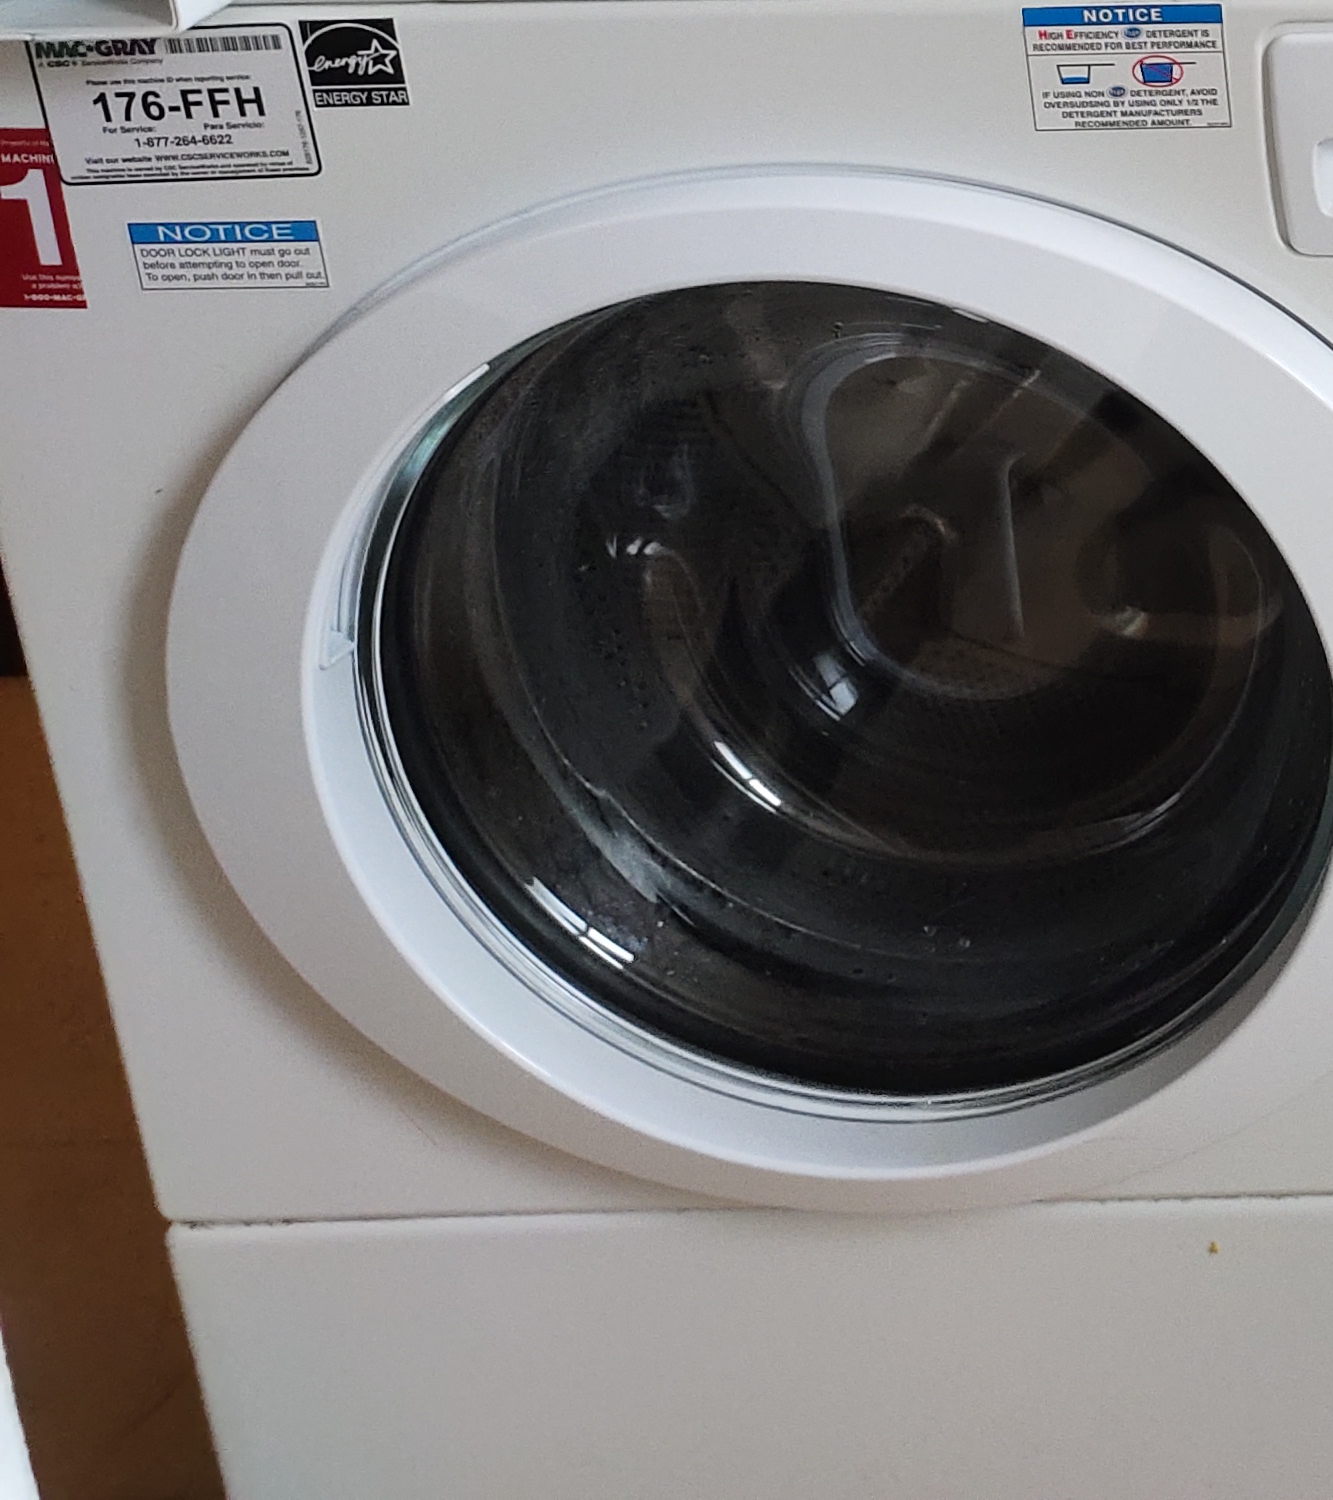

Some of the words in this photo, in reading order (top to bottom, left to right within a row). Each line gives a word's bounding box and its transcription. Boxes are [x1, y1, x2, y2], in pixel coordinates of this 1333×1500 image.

[1082, 7, 1161, 22] NOTICE
[92, 86, 265, 122] 176-FFH
[314, 91, 368, 105] ENERGY
[371, 90, 409, 103] STAR
[134, 133, 232, 147] 1-877-264-6622
[0, 169, 63, 266] 1
[156, 223, 293, 241] NOTICE
